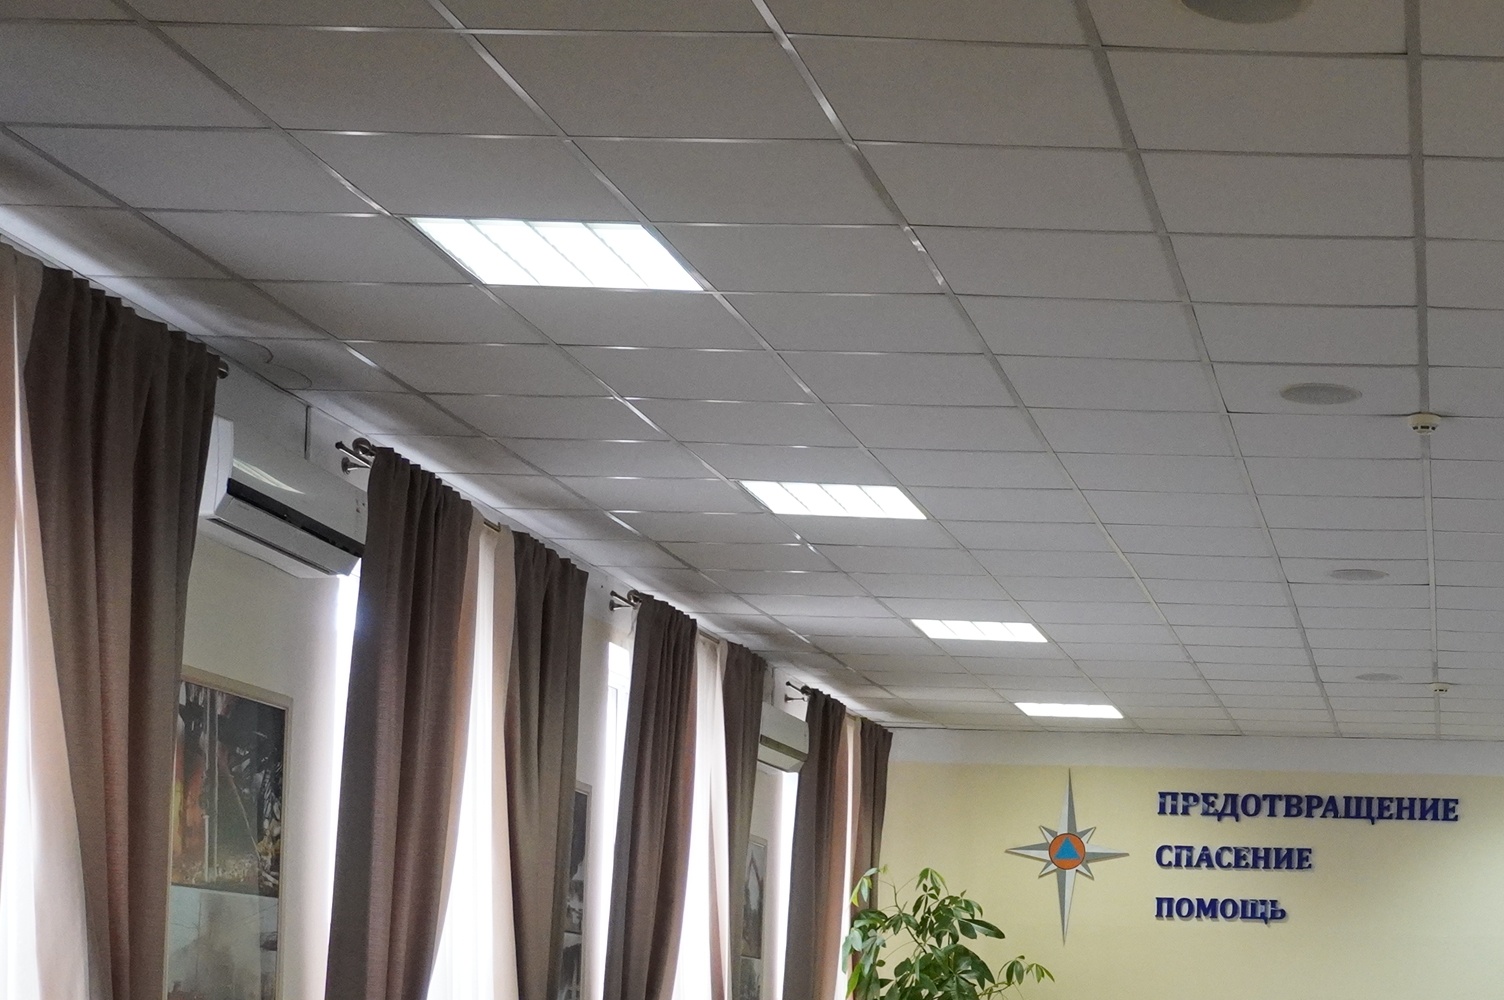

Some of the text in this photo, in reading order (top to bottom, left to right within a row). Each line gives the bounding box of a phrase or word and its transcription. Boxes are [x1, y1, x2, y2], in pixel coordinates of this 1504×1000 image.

[1157, 791, 1459, 825] ПРЕДОТВРАЩЕНИЕ
[1155, 844, 1313, 870] СПАСЕНИЕ
[1154, 896, 1287, 925] ПОМОЩЬ
